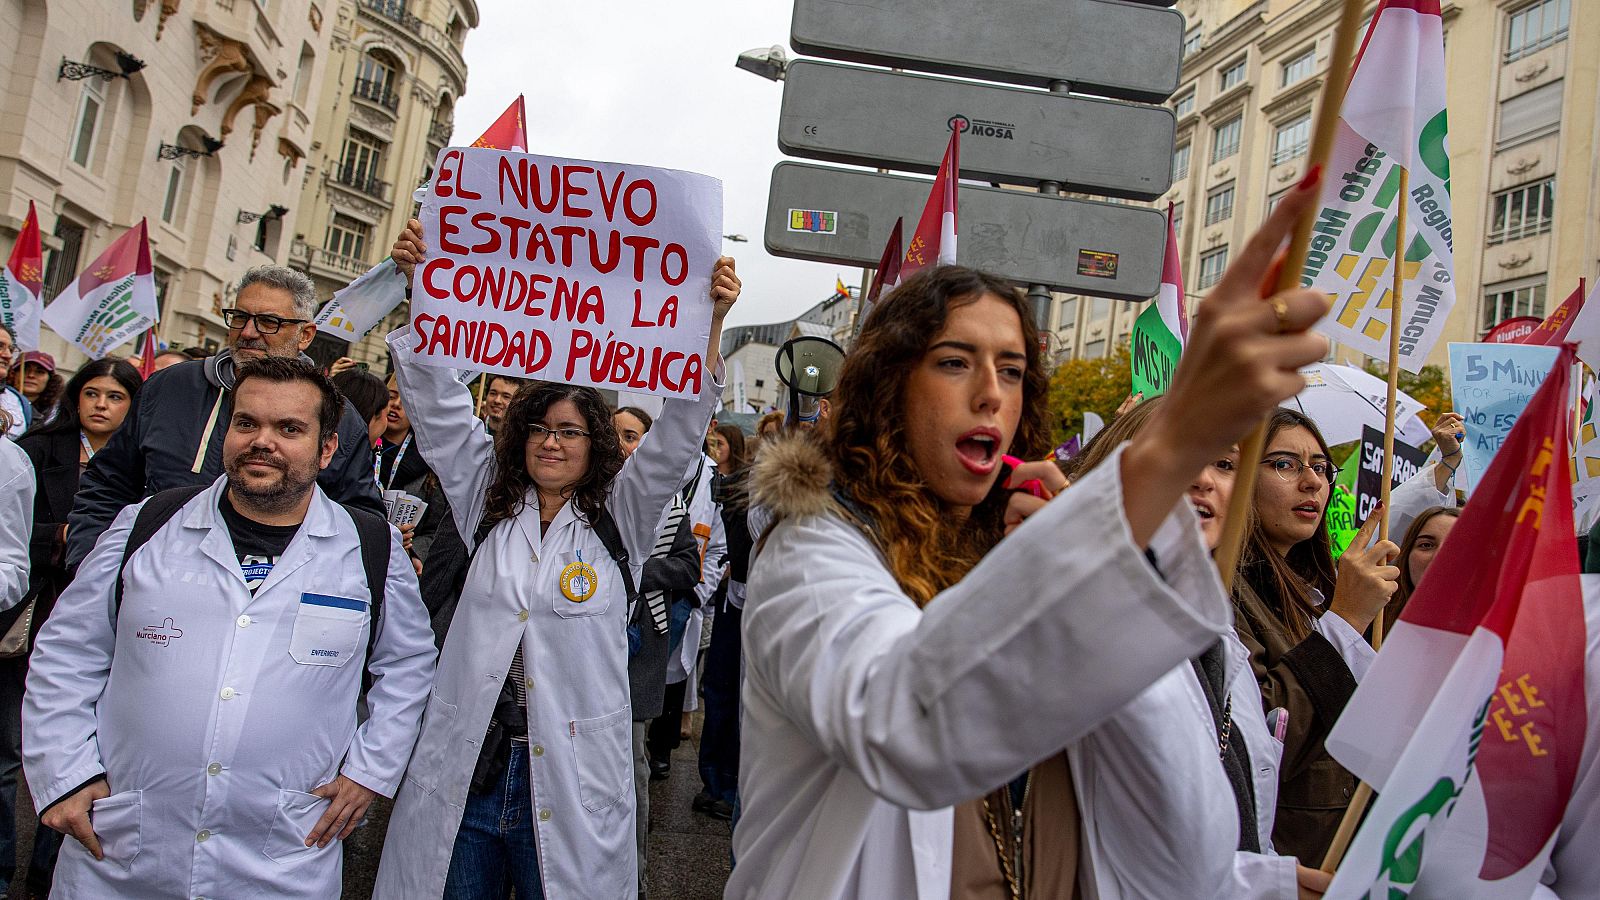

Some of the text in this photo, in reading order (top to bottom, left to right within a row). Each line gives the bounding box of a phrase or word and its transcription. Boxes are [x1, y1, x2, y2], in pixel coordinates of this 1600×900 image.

[971, 125, 1014, 140] MOSA
[435, 151, 658, 226] EL NUEVO
[1411, 183, 1453, 253] Regi
[439, 206, 689, 286] ESTATUTO
[422, 258, 680, 328] CONDENA LA
[413, 313, 702, 394] SANIDAD PÚBLICA
[1134, 326, 1160, 390] MIS
[1465, 355, 1489, 382] 5
[1464, 406, 1486, 426] NO
[136, 631, 167, 641] Murciano
[310, 649, 340, 658] ENFERMERO
